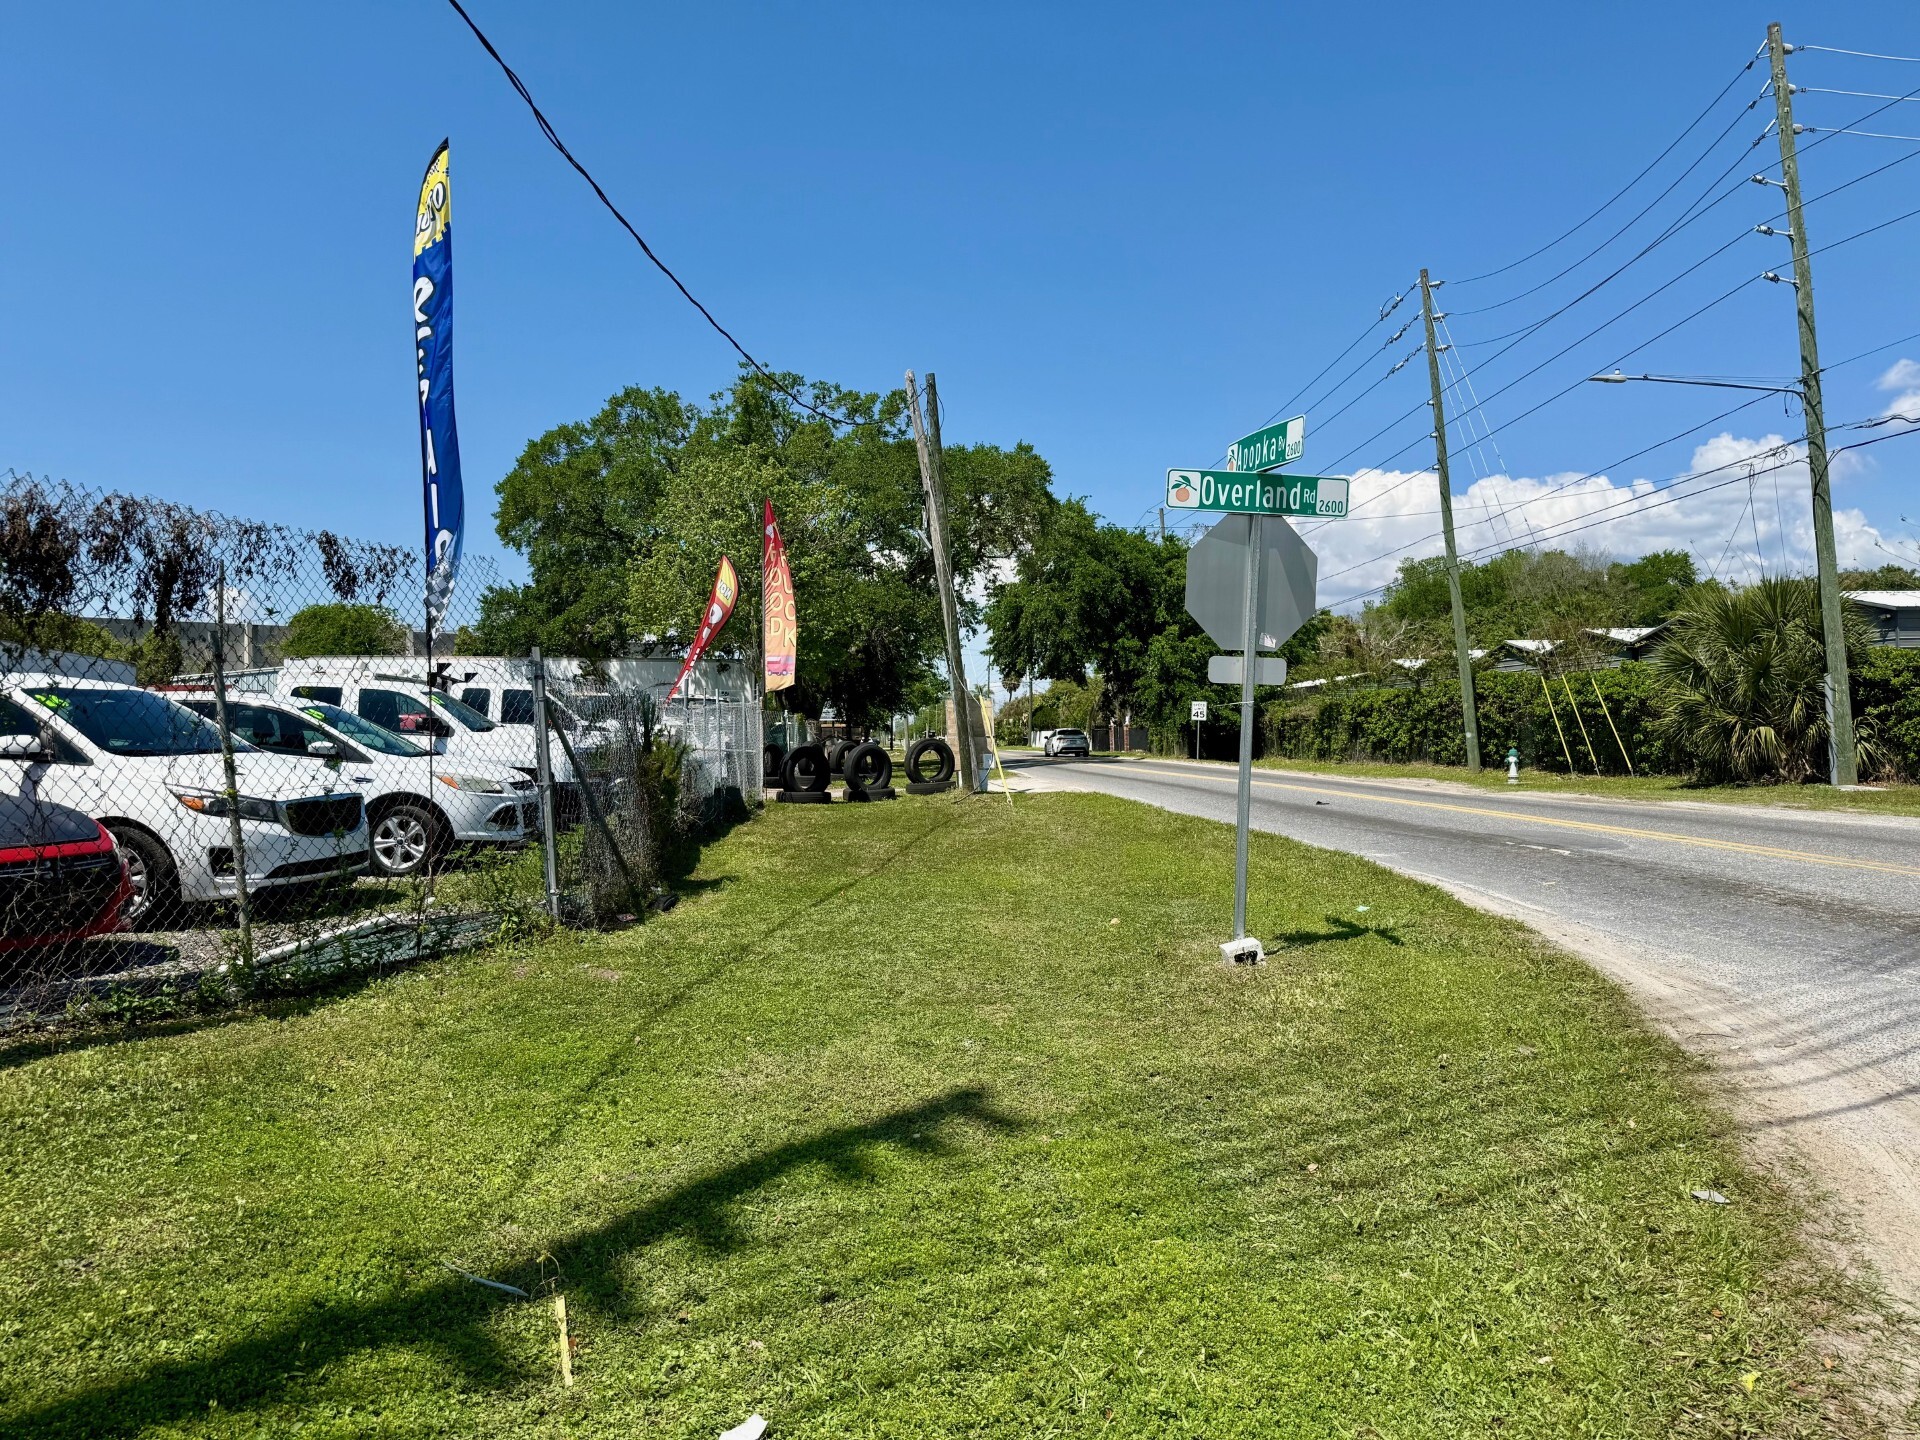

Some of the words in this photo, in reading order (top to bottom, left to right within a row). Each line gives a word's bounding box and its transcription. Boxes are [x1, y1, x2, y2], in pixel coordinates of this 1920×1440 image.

[1236, 434, 1276, 472] Apopka
[1287, 440, 1301, 457] 2600
[1201, 475, 1302, 510] Overland
[1303, 487, 1316, 504] Rd
[1318, 499, 1344, 514] 2600
[1193, 710, 1205, 718] 45
